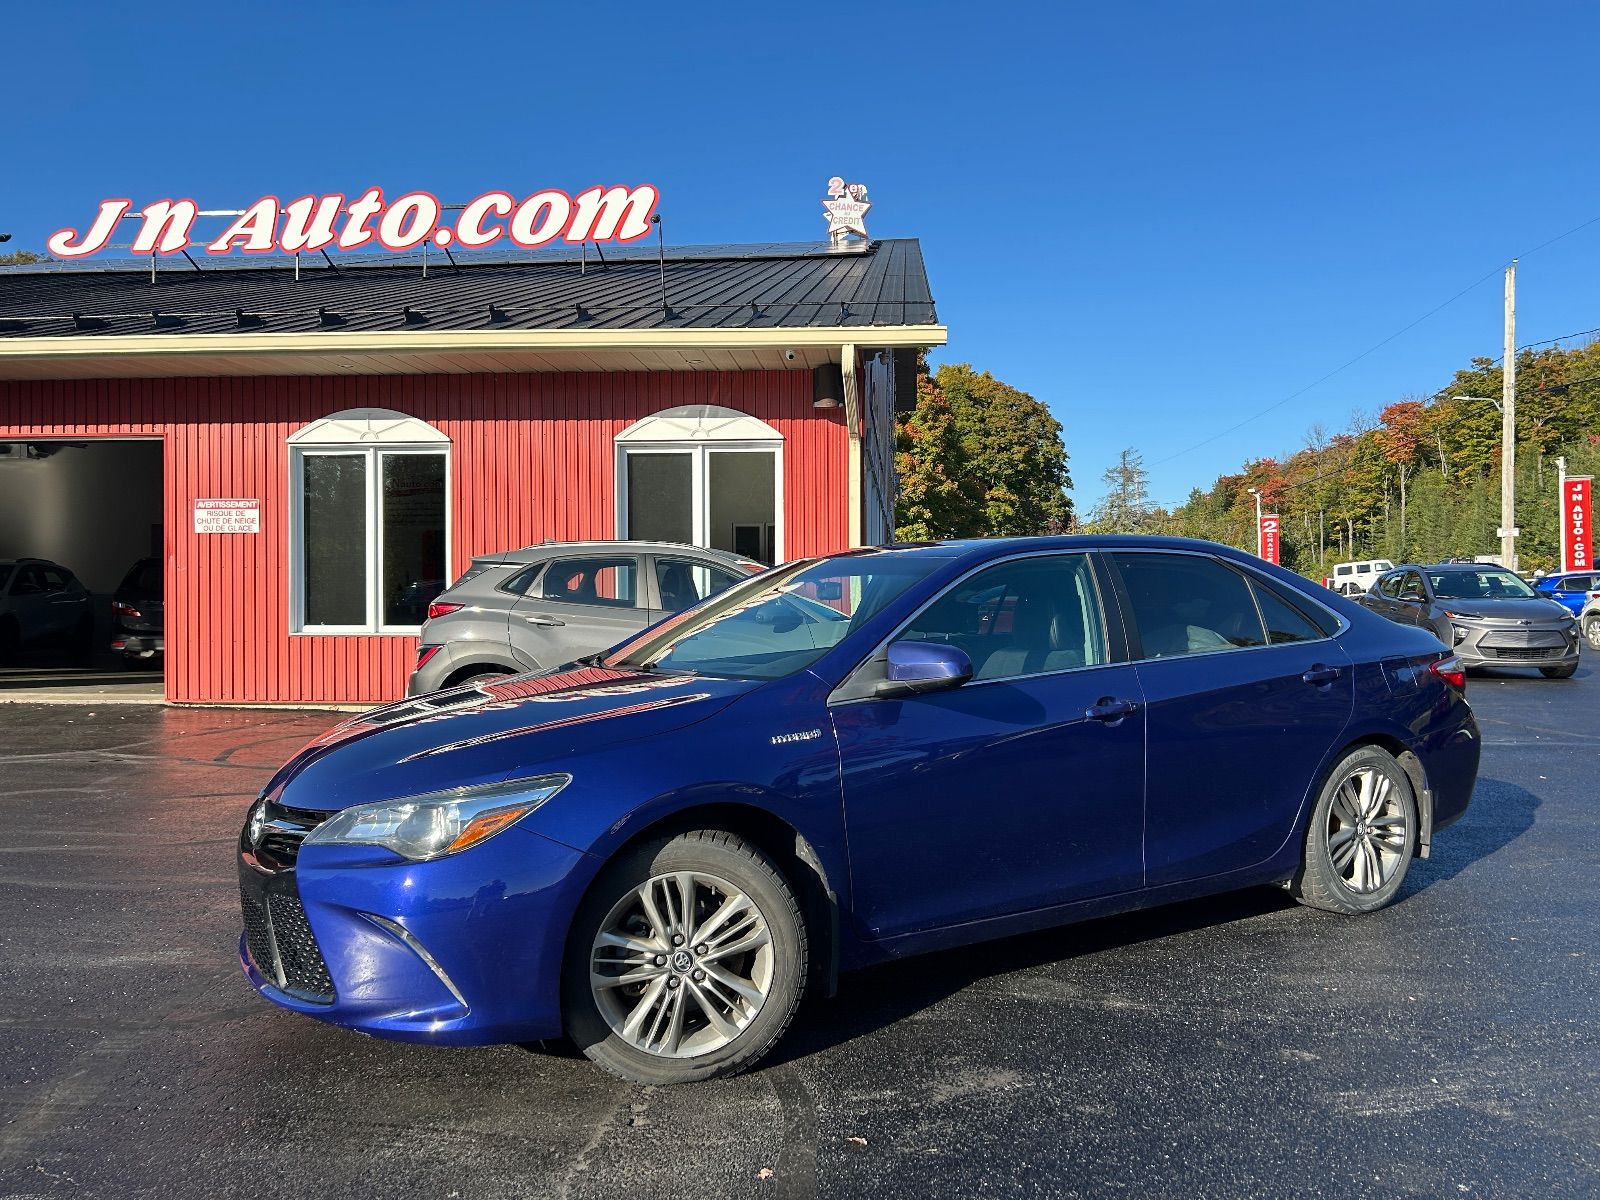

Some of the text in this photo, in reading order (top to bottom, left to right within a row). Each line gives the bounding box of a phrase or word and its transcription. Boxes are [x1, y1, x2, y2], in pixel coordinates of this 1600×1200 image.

[829, 203, 864, 212] CHANCE
[206, 184, 660, 253] Auto.com
[197, 501, 257, 509] AVERTISSEMENT
[1263, 520, 1278, 533] 2
